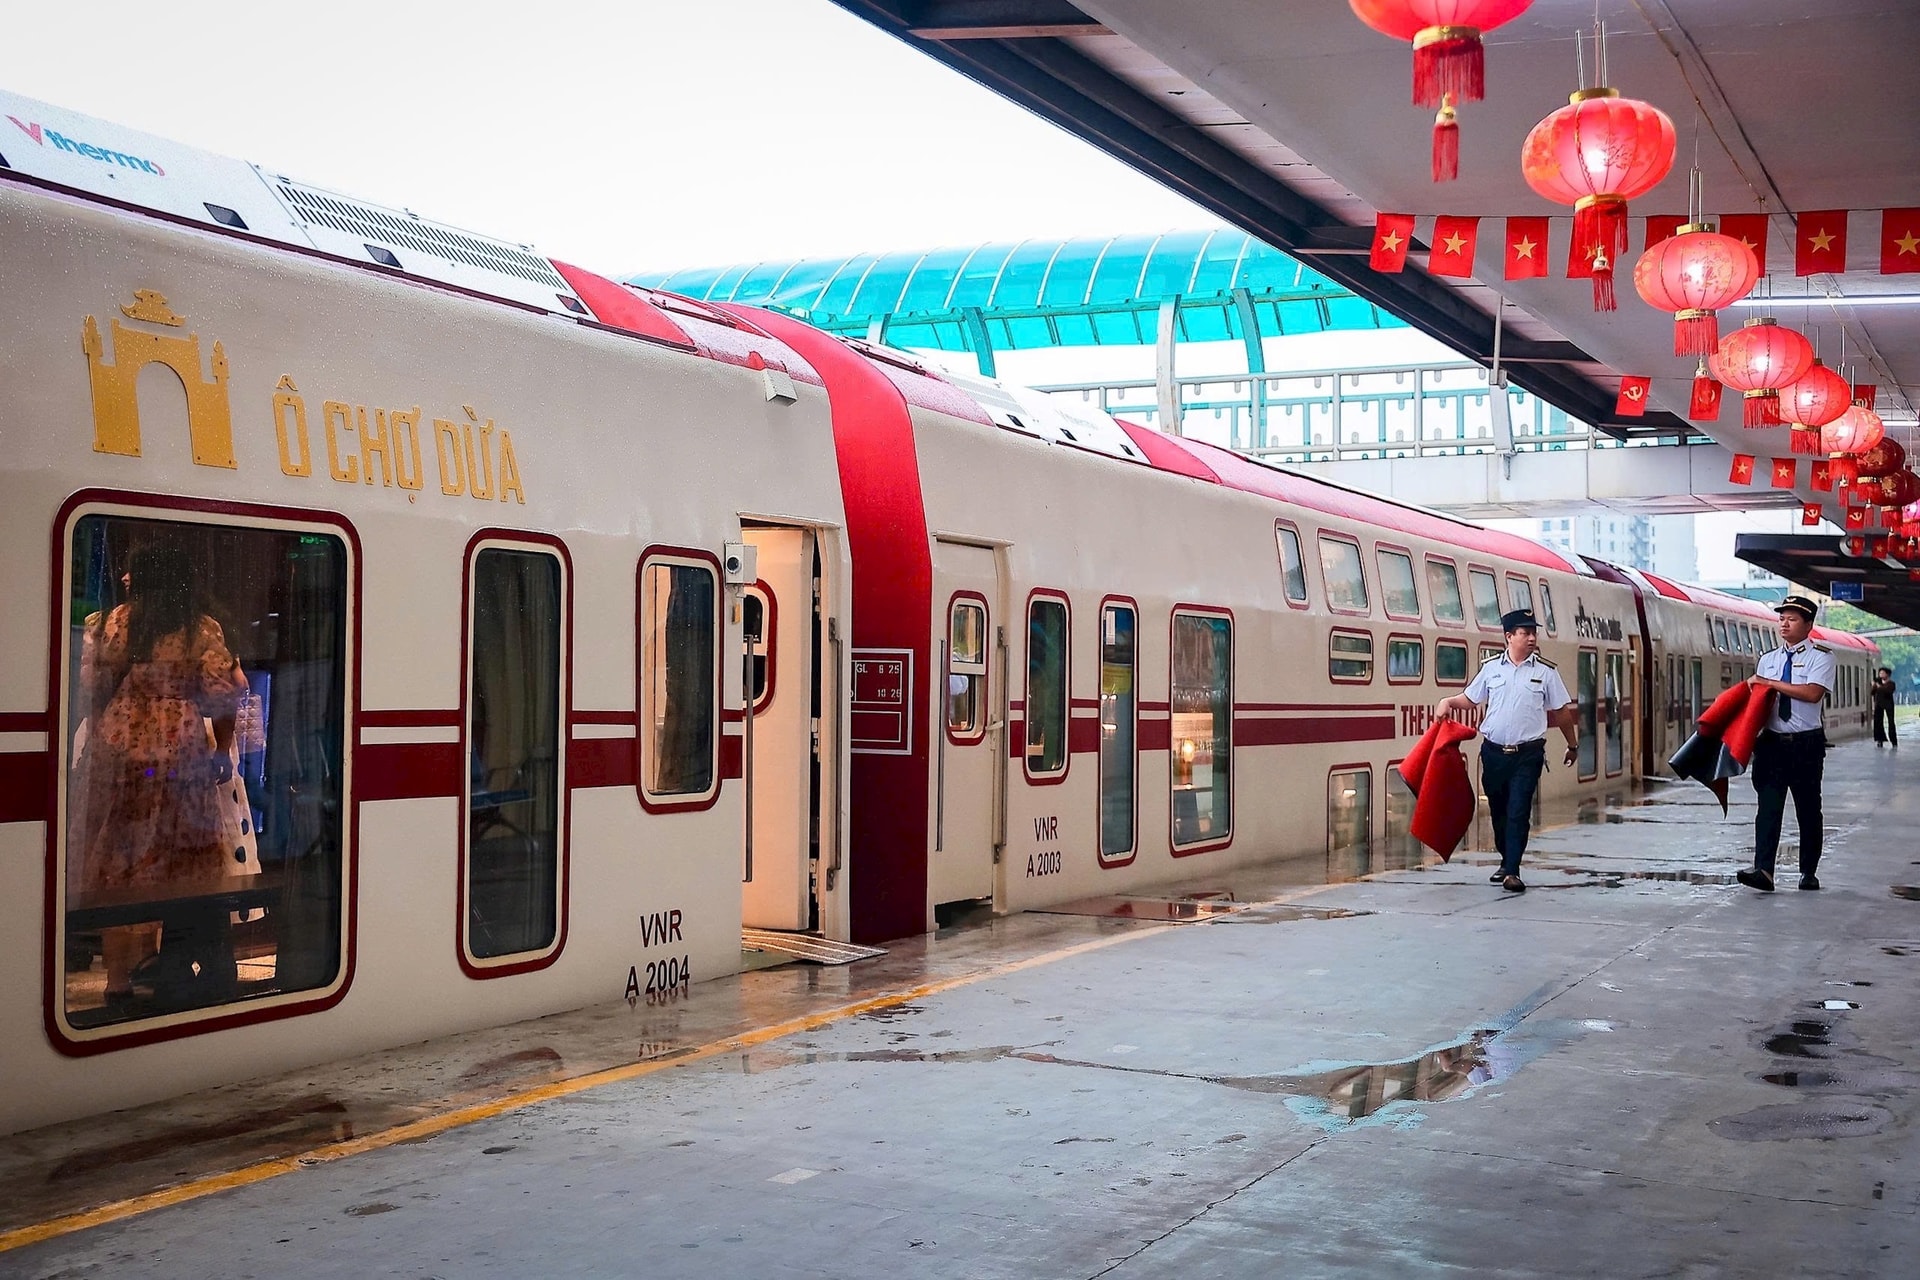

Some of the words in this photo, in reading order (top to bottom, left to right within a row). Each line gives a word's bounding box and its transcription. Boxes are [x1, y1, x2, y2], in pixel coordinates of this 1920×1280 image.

[272, 373, 312, 478] Ô
[323, 400, 424, 504] CHỢ
[433, 404, 525, 504] DỪA
[1401, 704, 1424, 736] THE
[1033, 816, 1058, 842] VNR
[1026, 854, 1035, 879] A
[1037, 850, 1061, 877] 2003
[639, 909, 683, 948] VNR
[624, 965, 640, 999] A
[644, 954, 690, 995] 2004
